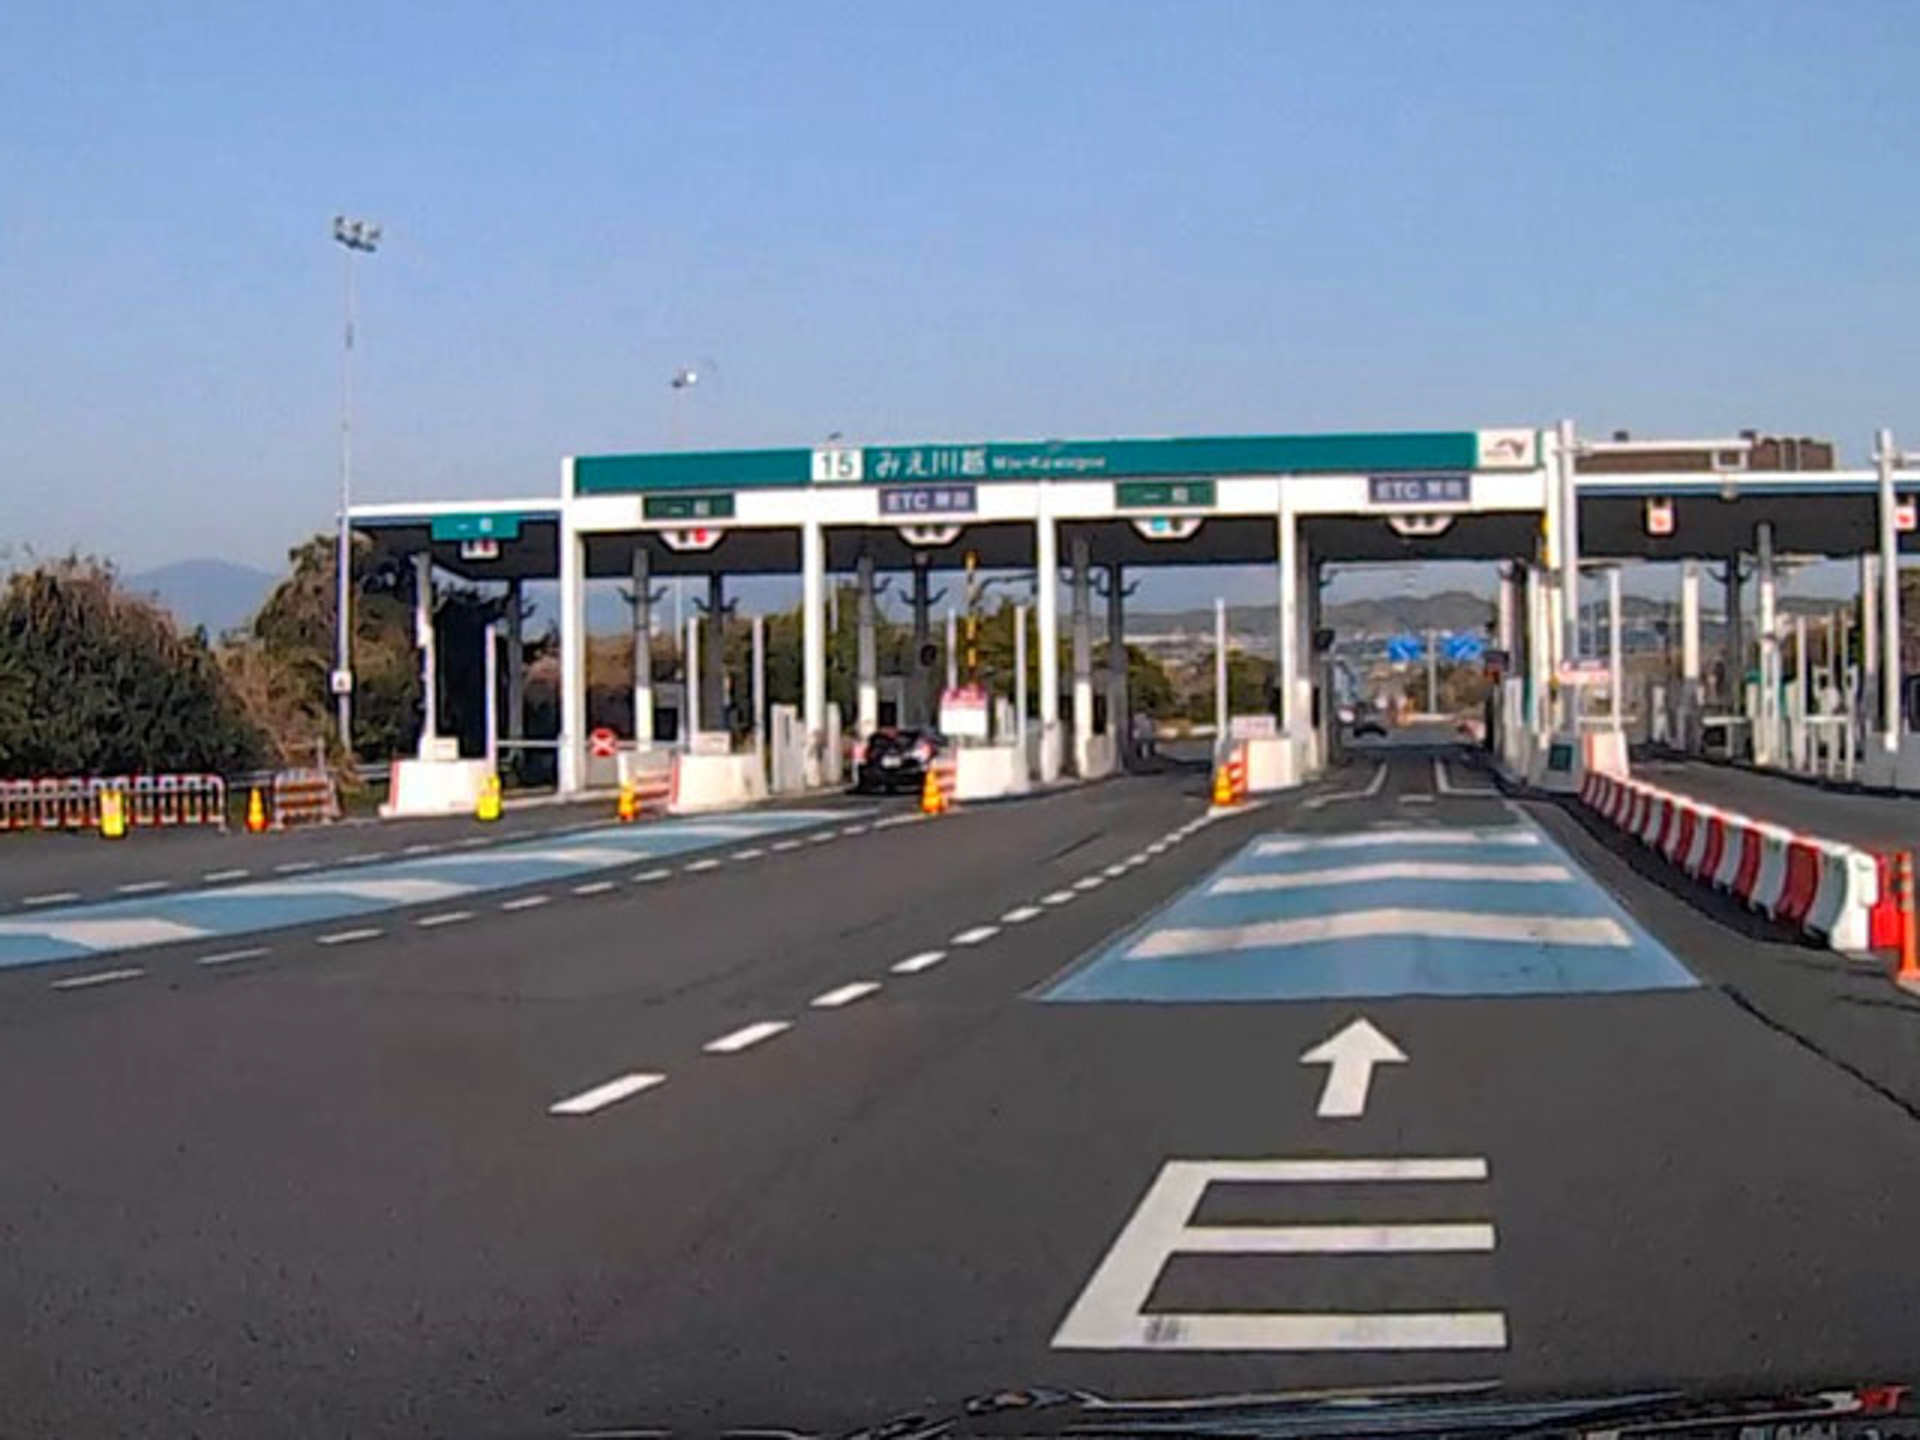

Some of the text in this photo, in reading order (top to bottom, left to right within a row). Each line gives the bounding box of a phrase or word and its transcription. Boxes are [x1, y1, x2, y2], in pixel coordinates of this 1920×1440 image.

[821, 452, 854, 478] 15
[887, 490, 928, 511] ETC
[1375, 481, 1420, 500] ETC
[1050, 1158, 1508, 1349] E
